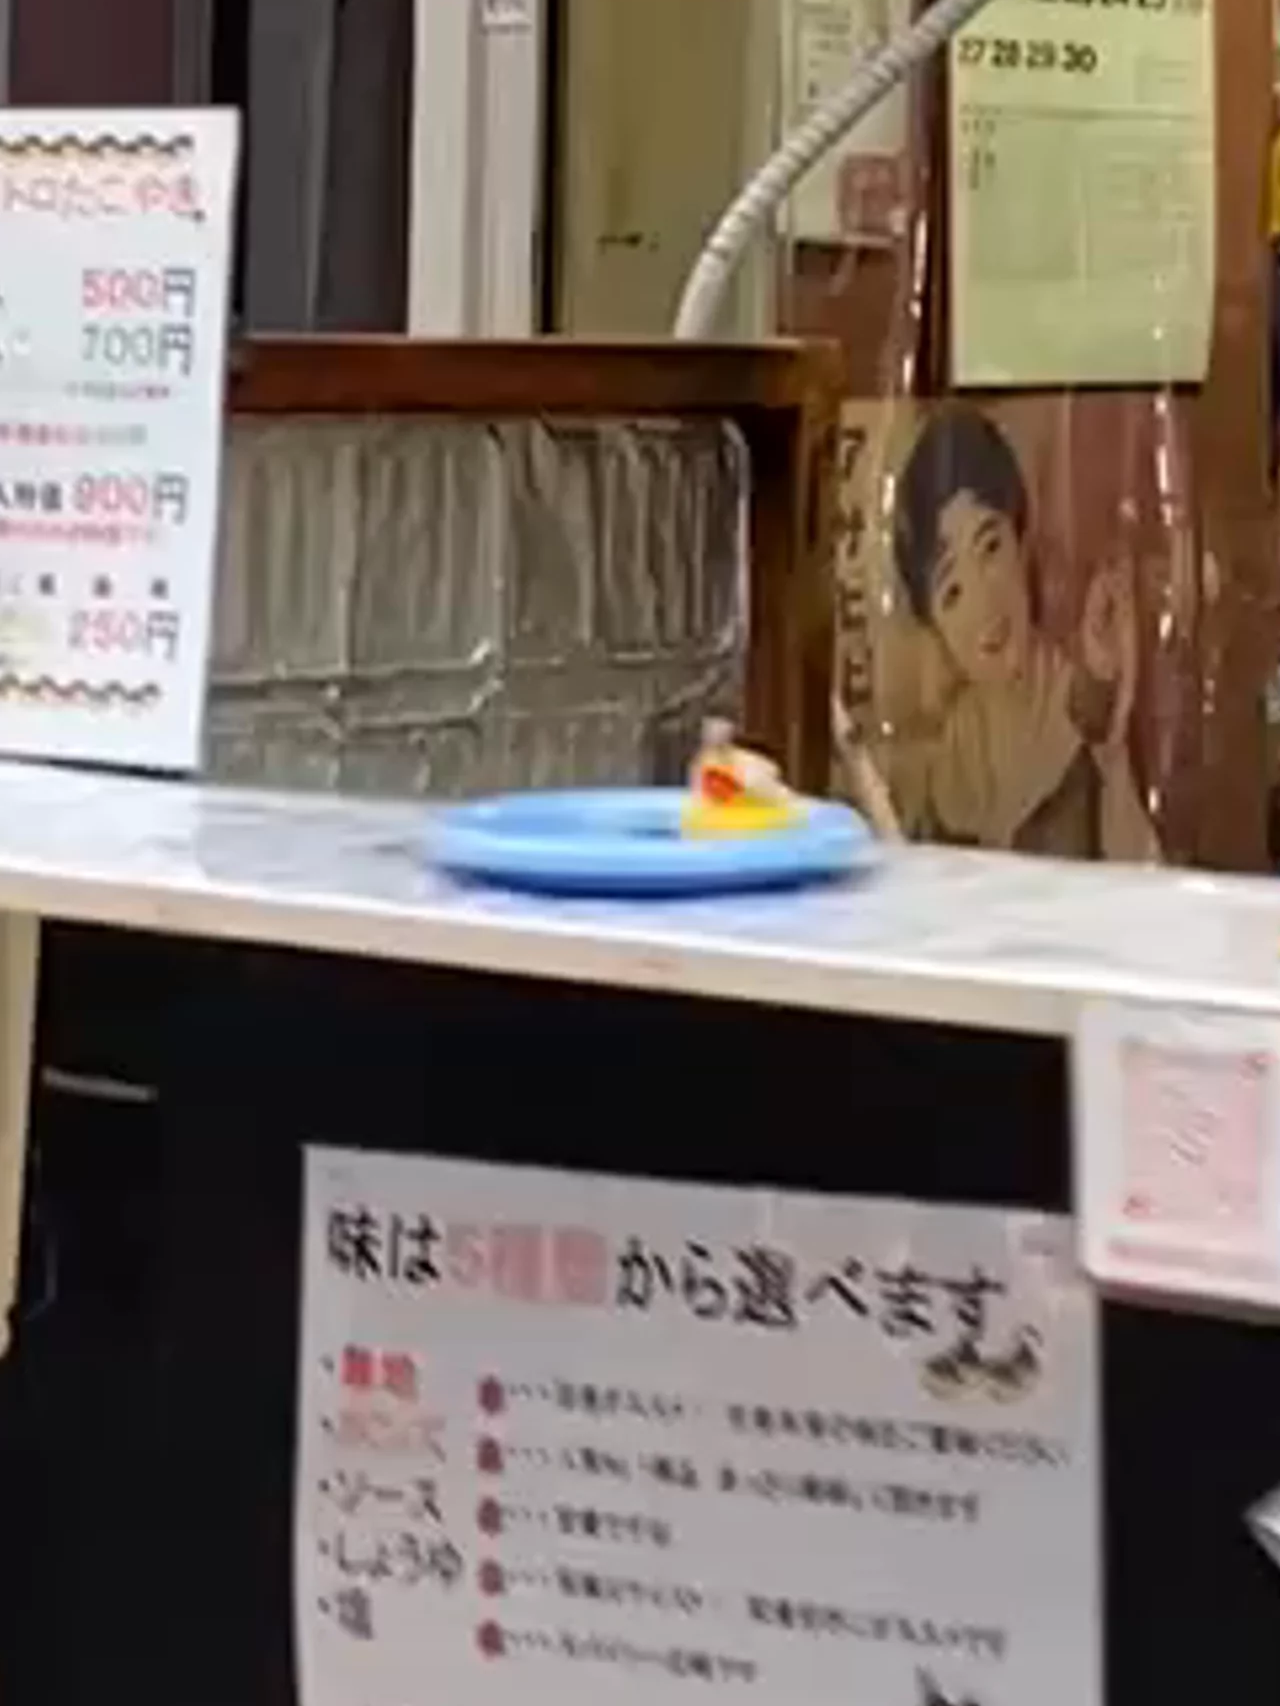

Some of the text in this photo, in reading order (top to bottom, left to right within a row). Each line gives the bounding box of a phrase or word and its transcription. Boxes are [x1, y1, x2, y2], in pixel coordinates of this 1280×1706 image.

[991, 38, 1019, 68] 28
[1062, 42, 1098, 74] 30
[81, 323, 193, 378] 700円
